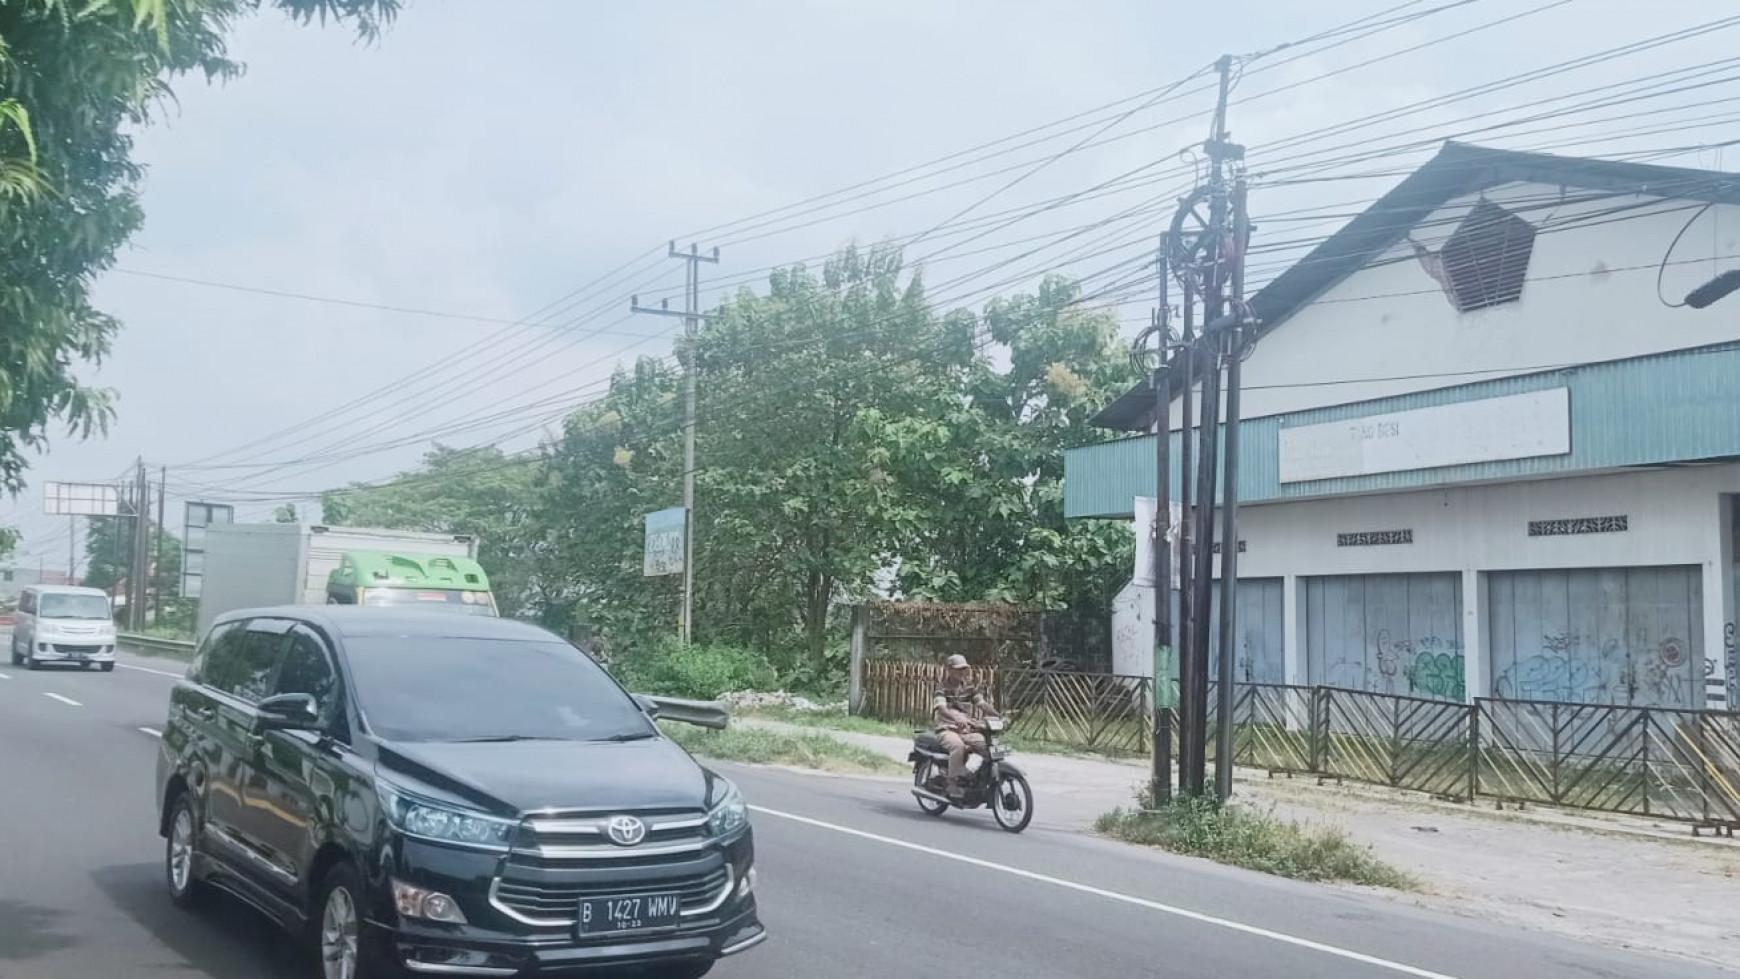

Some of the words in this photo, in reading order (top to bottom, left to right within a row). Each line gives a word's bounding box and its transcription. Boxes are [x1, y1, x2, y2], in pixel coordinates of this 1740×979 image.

[583, 902, 592, 923] B
[607, 899, 641, 921] 1427
[648, 896, 677, 917] WMV
